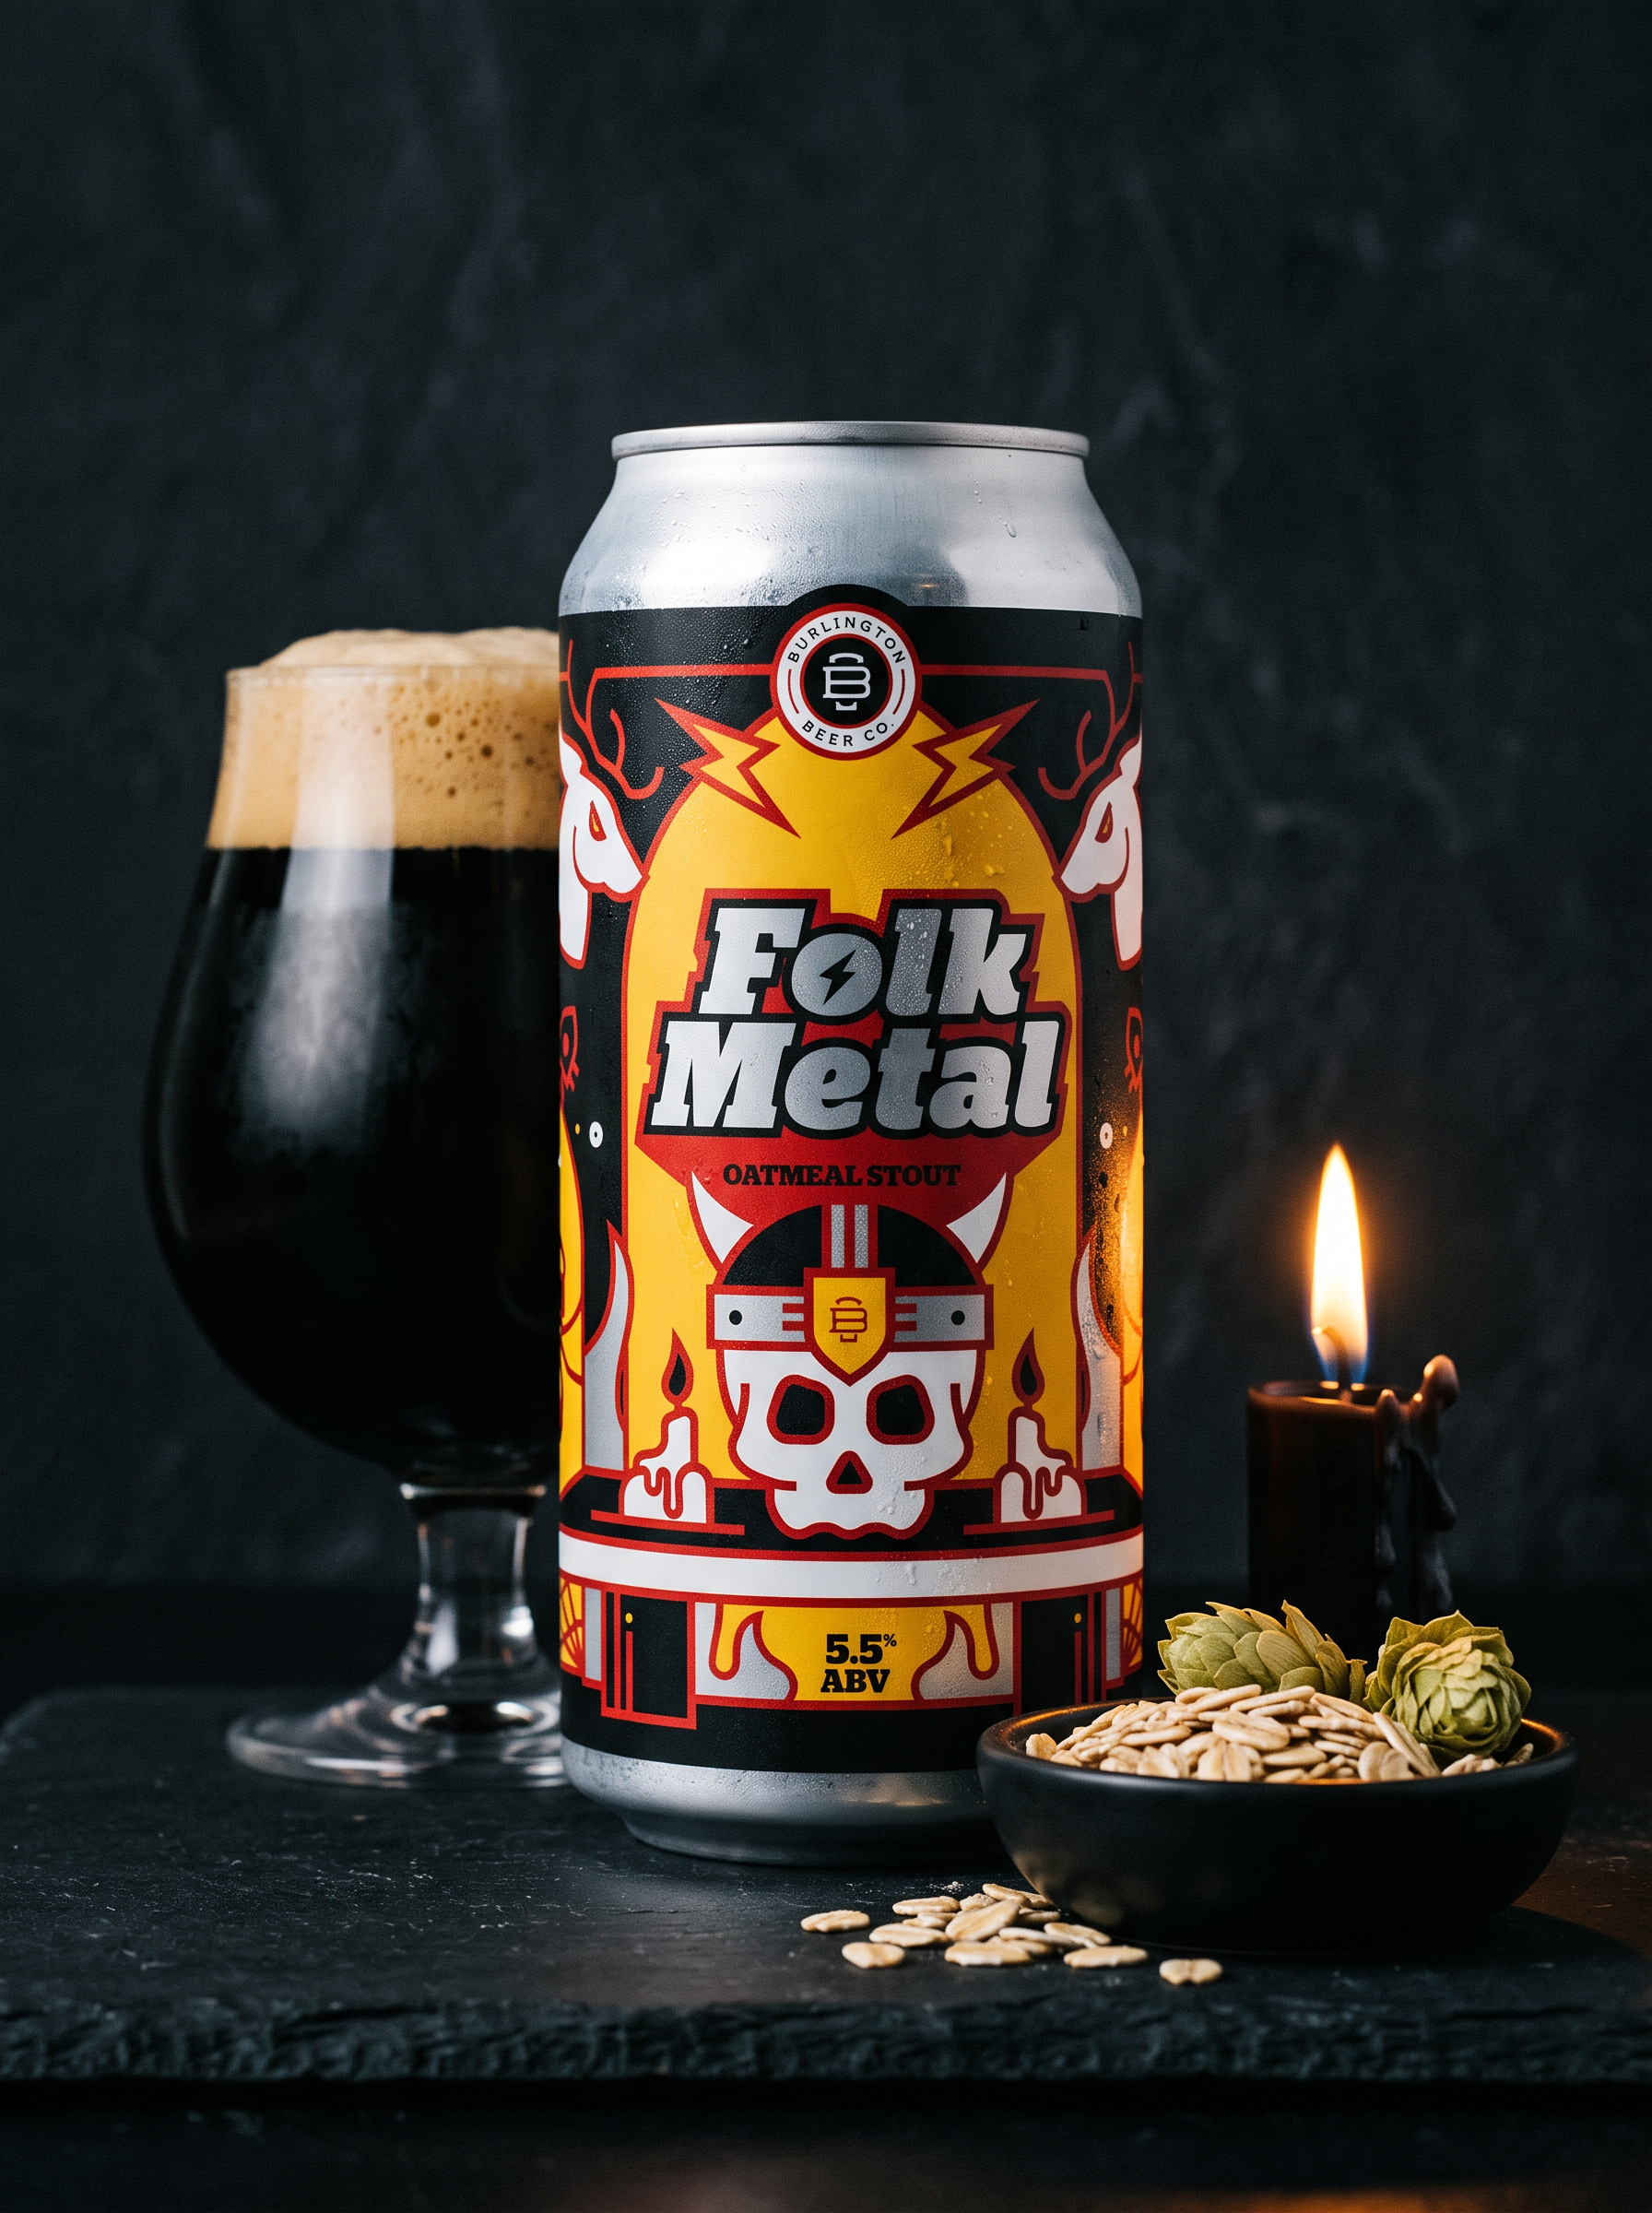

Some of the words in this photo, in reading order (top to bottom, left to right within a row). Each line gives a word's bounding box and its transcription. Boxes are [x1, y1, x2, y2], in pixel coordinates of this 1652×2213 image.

[788, 617, 906, 663] BURLINGTON
[802, 720, 854, 747] BEER
[864, 722, 894, 741] CO.
[698, 907, 1027, 1017] Folk
[651, 1020, 1060, 1130] Metal
[723, 1164, 863, 1187] OATMEAL
[867, 1165, 962, 1187] STOUT
[826, 1633, 898, 1665] 5.5%
[820, 1669, 891, 1694] ABV
